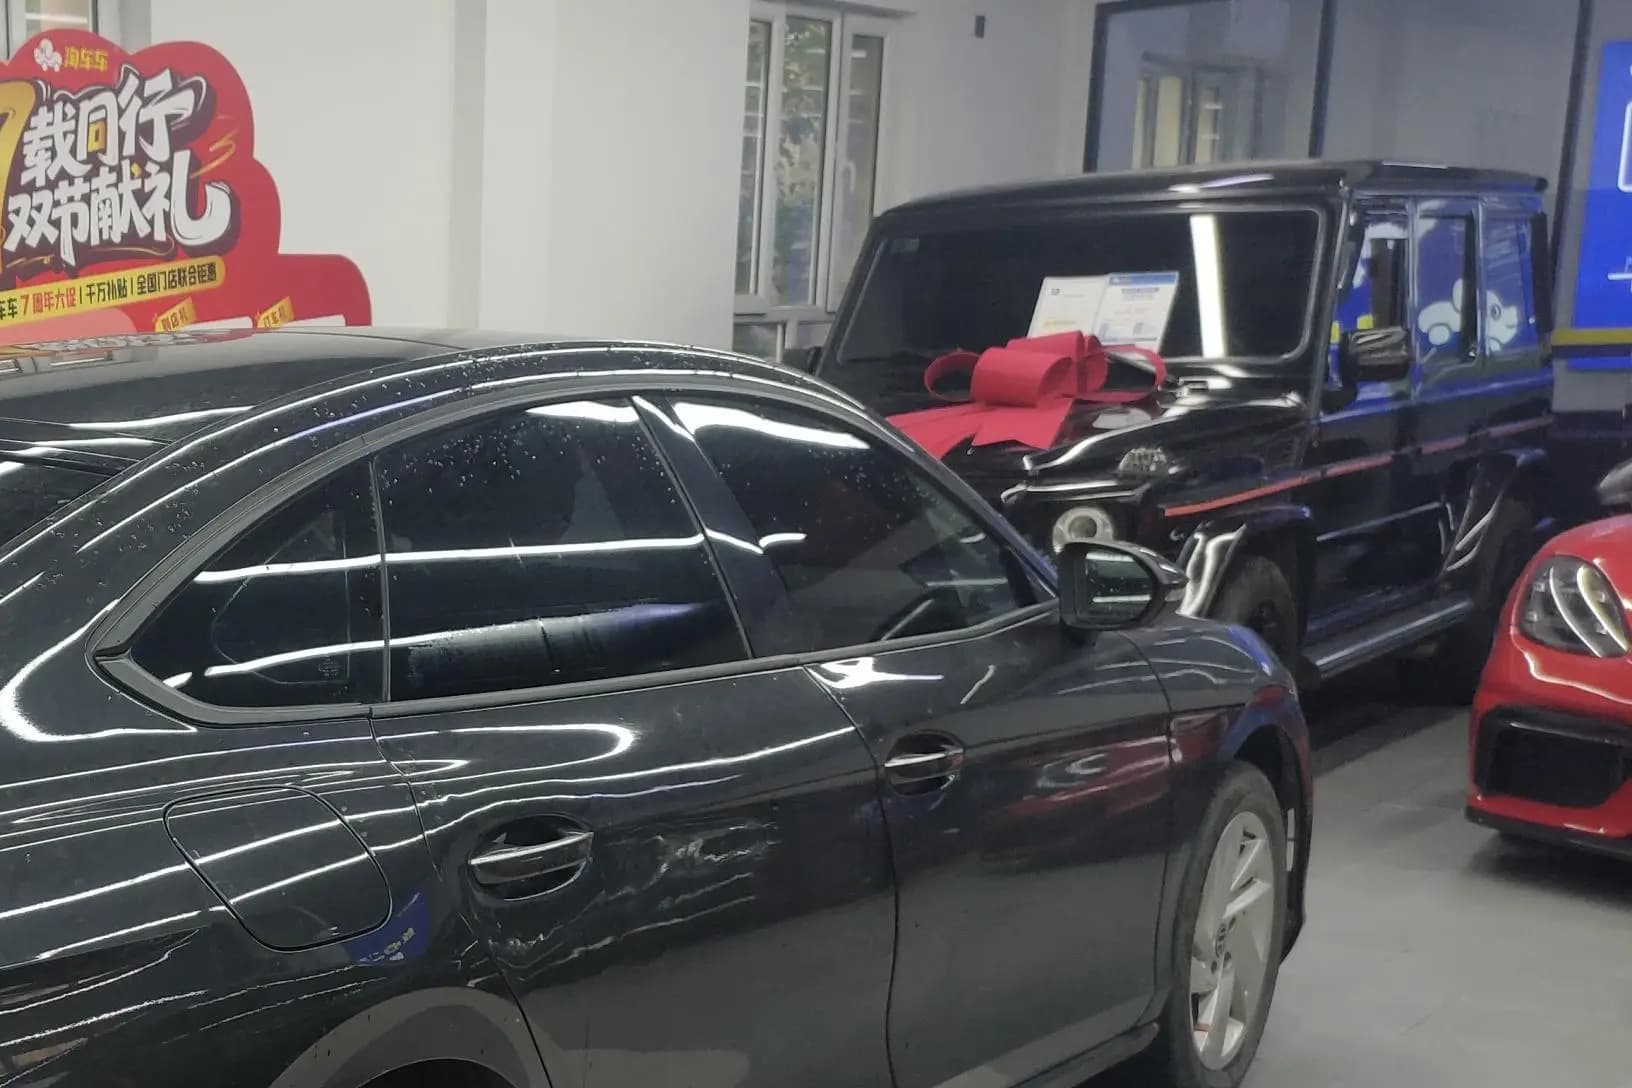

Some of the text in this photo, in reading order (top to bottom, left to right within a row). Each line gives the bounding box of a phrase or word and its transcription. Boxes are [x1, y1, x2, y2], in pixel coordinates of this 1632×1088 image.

[64, 46, 108, 72] 淘车车
[3, 149, 232, 268] 双节献礼
